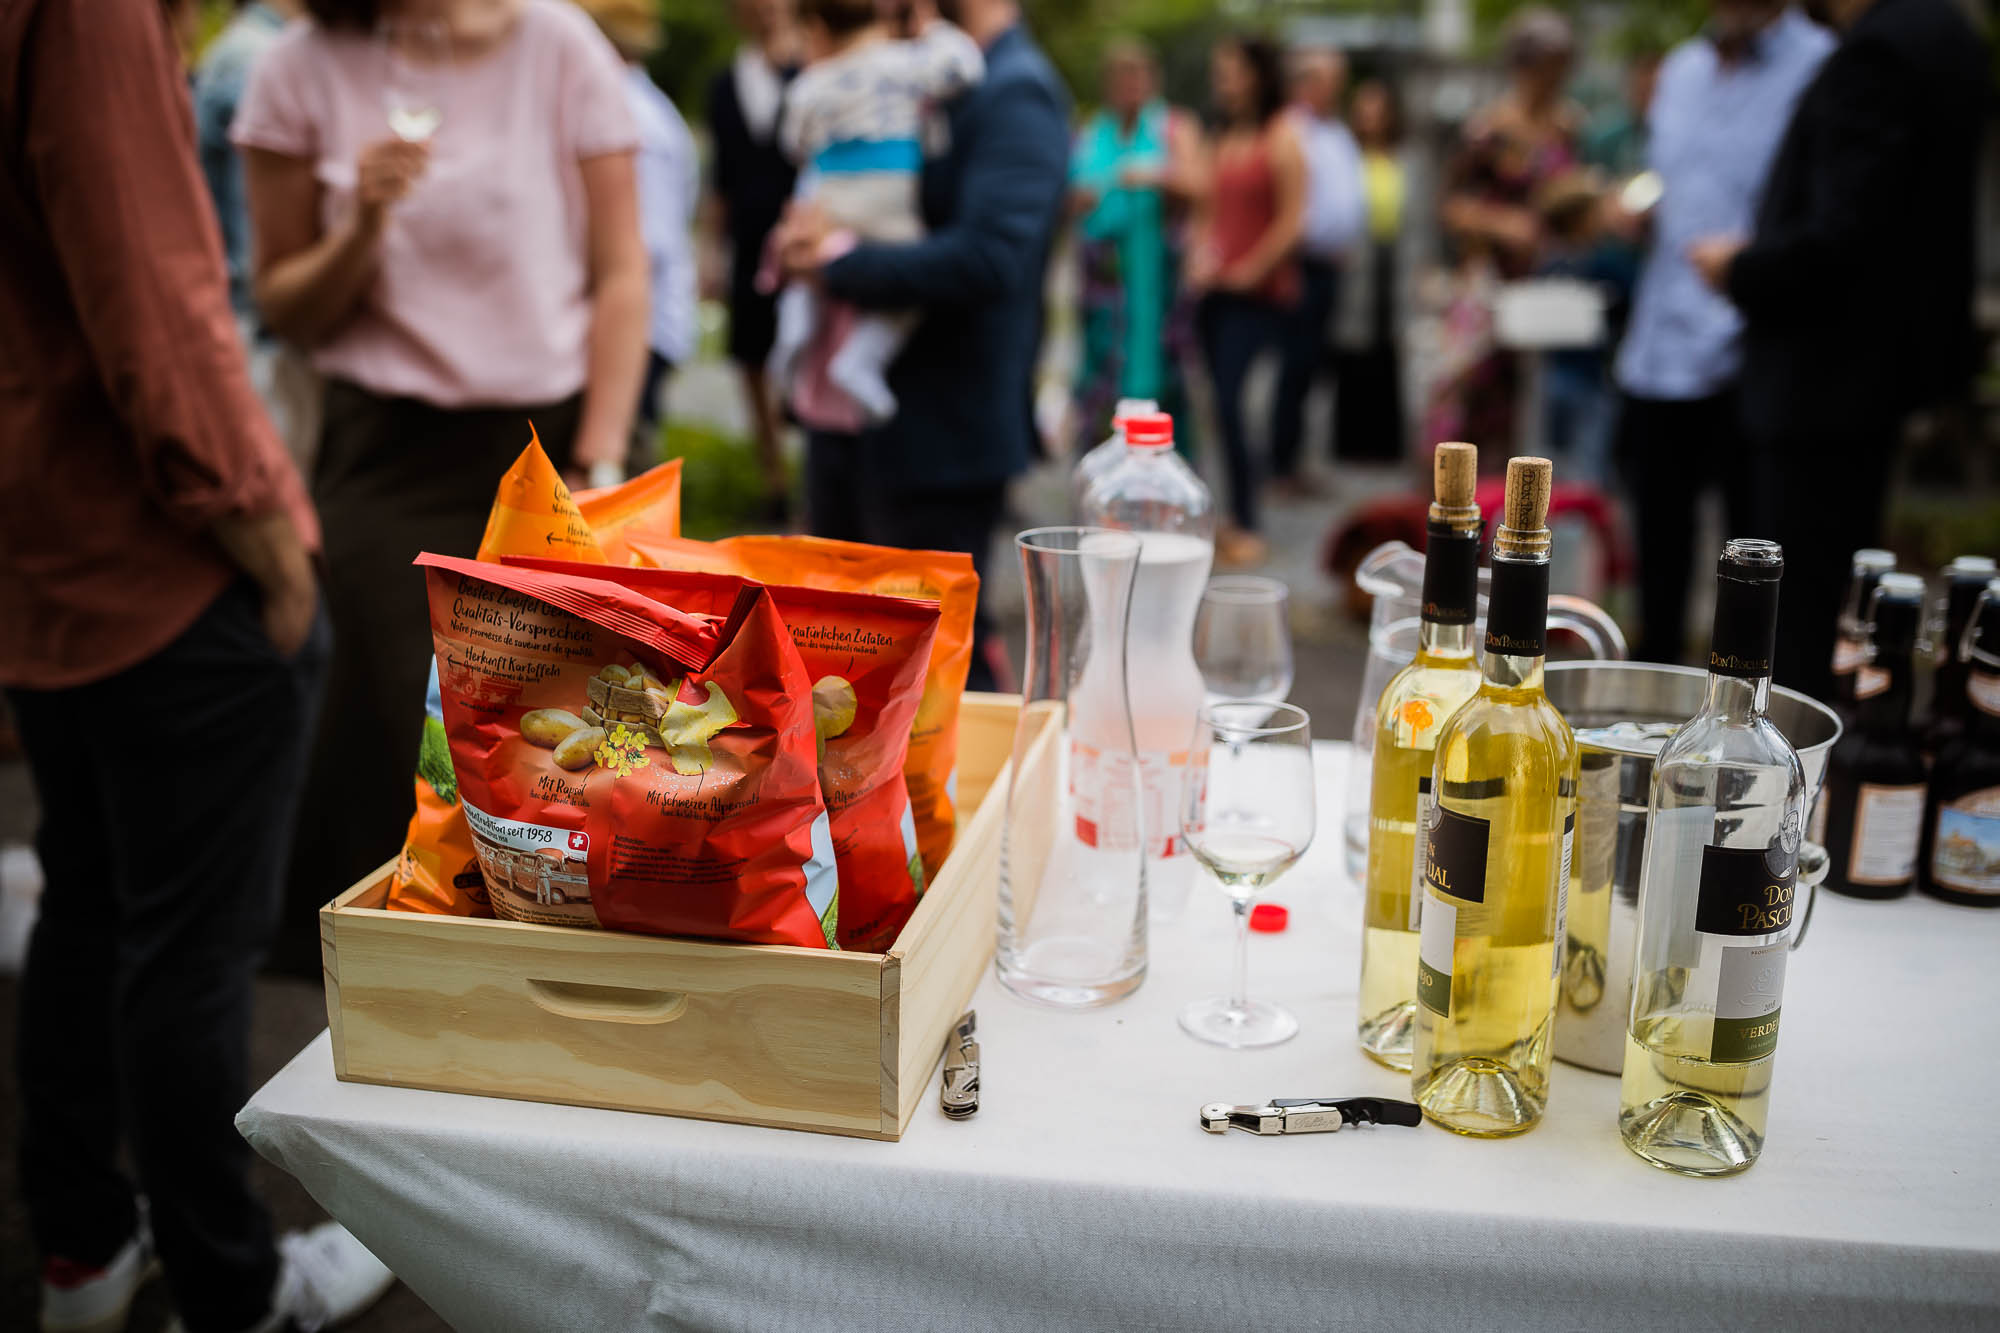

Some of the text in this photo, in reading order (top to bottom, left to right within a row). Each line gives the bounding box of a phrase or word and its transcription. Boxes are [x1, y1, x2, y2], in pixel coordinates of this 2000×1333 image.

[503, 633, 513, 646] de
[793, 625, 852, 643] natürlichen
[853, 627, 893, 647] Zutaten
[465, 646, 561, 679] Herkunft Kartoffeln
[1711, 651, 1729, 668] DON
[537, 775, 587, 799] Mit Rapsöl
[646, 789, 662, 806] Mit
[662, 791, 708, 811] Schweizer
[507, 826, 525, 839] seit
[526, 827, 553, 843] 1958
[1763, 884, 1796, 906] DON
[1737, 902, 1793, 929] PASCU
